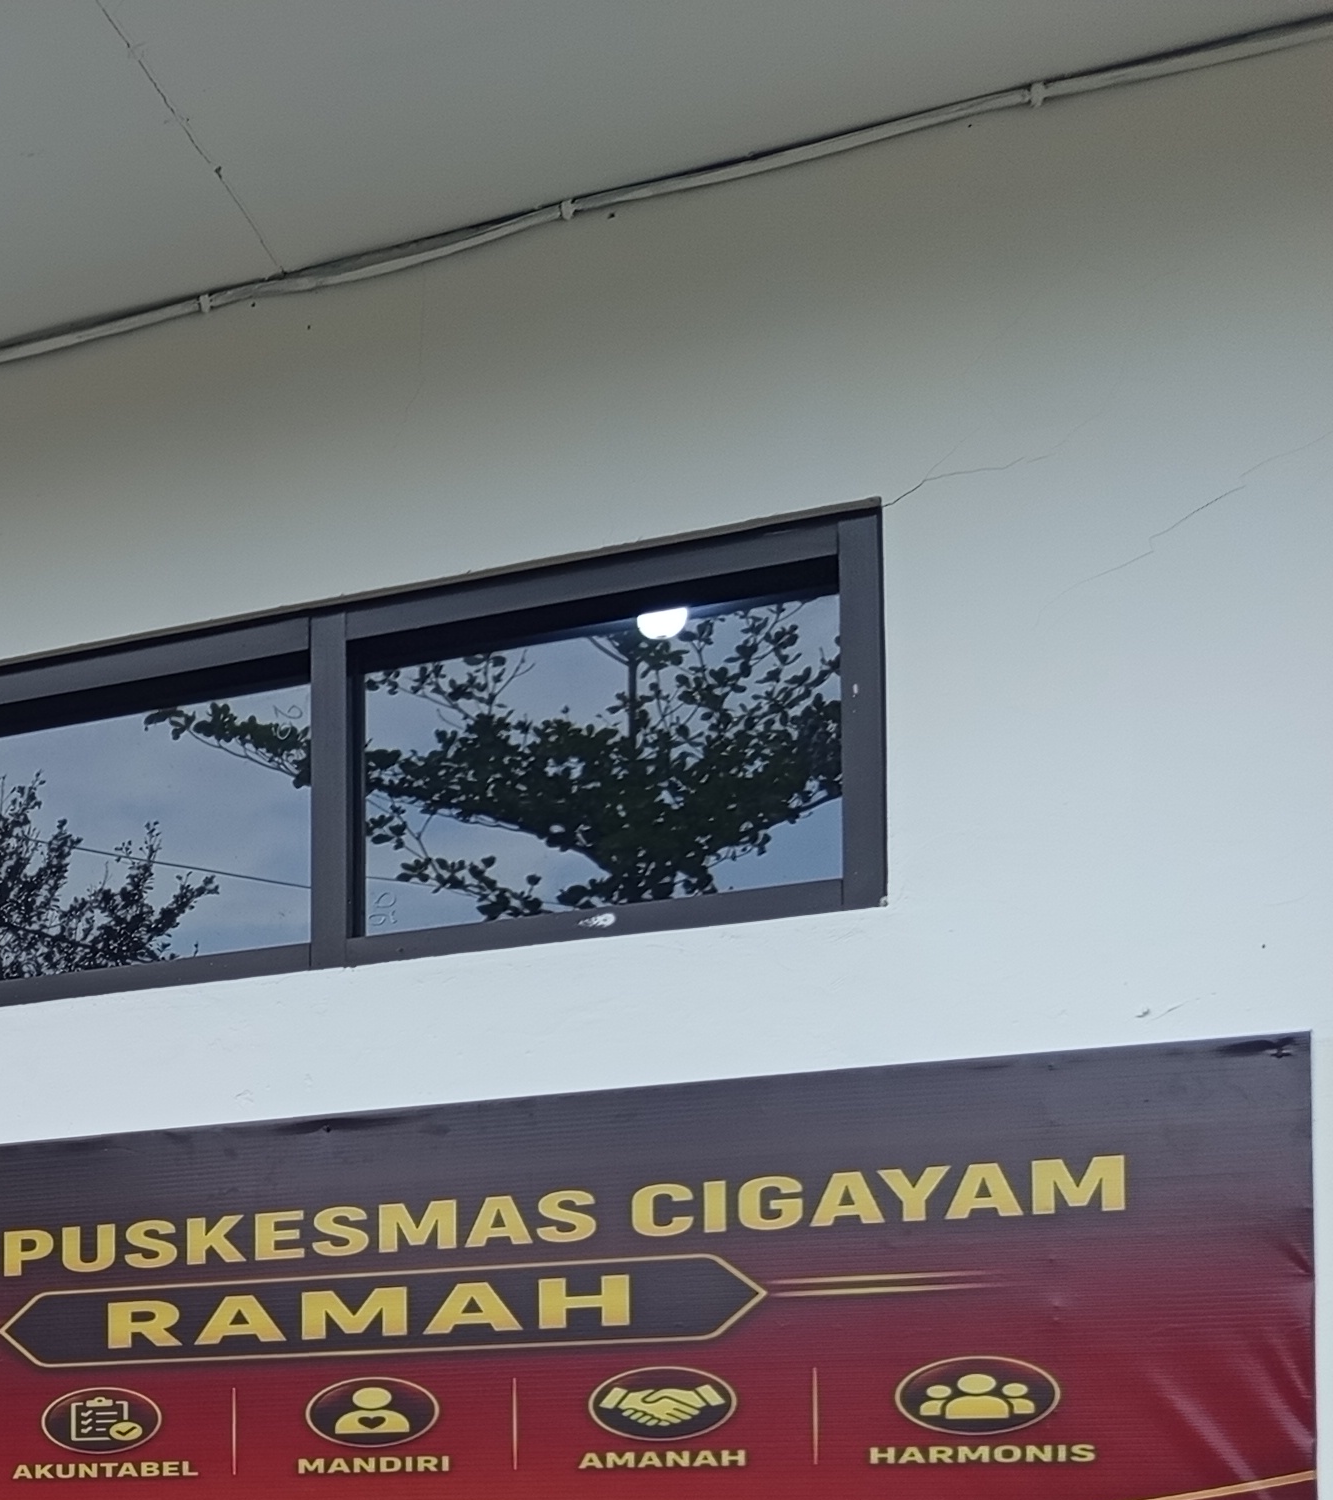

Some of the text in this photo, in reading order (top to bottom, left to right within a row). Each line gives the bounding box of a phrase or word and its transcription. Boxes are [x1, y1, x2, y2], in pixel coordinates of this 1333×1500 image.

[2, 1189, 597, 1277] PUSKESMAS
[630, 1154, 1127, 1237] CIGAYAM
[105, 1273, 631, 1350] RAMAH
[297, 1454, 451, 1475] MANDIRI
[577, 1448, 747, 1470] AMANAH
[868, 1442, 1097, 1466] HARMONIS
[12, 1459, 199, 1482] AKUNTABEL
